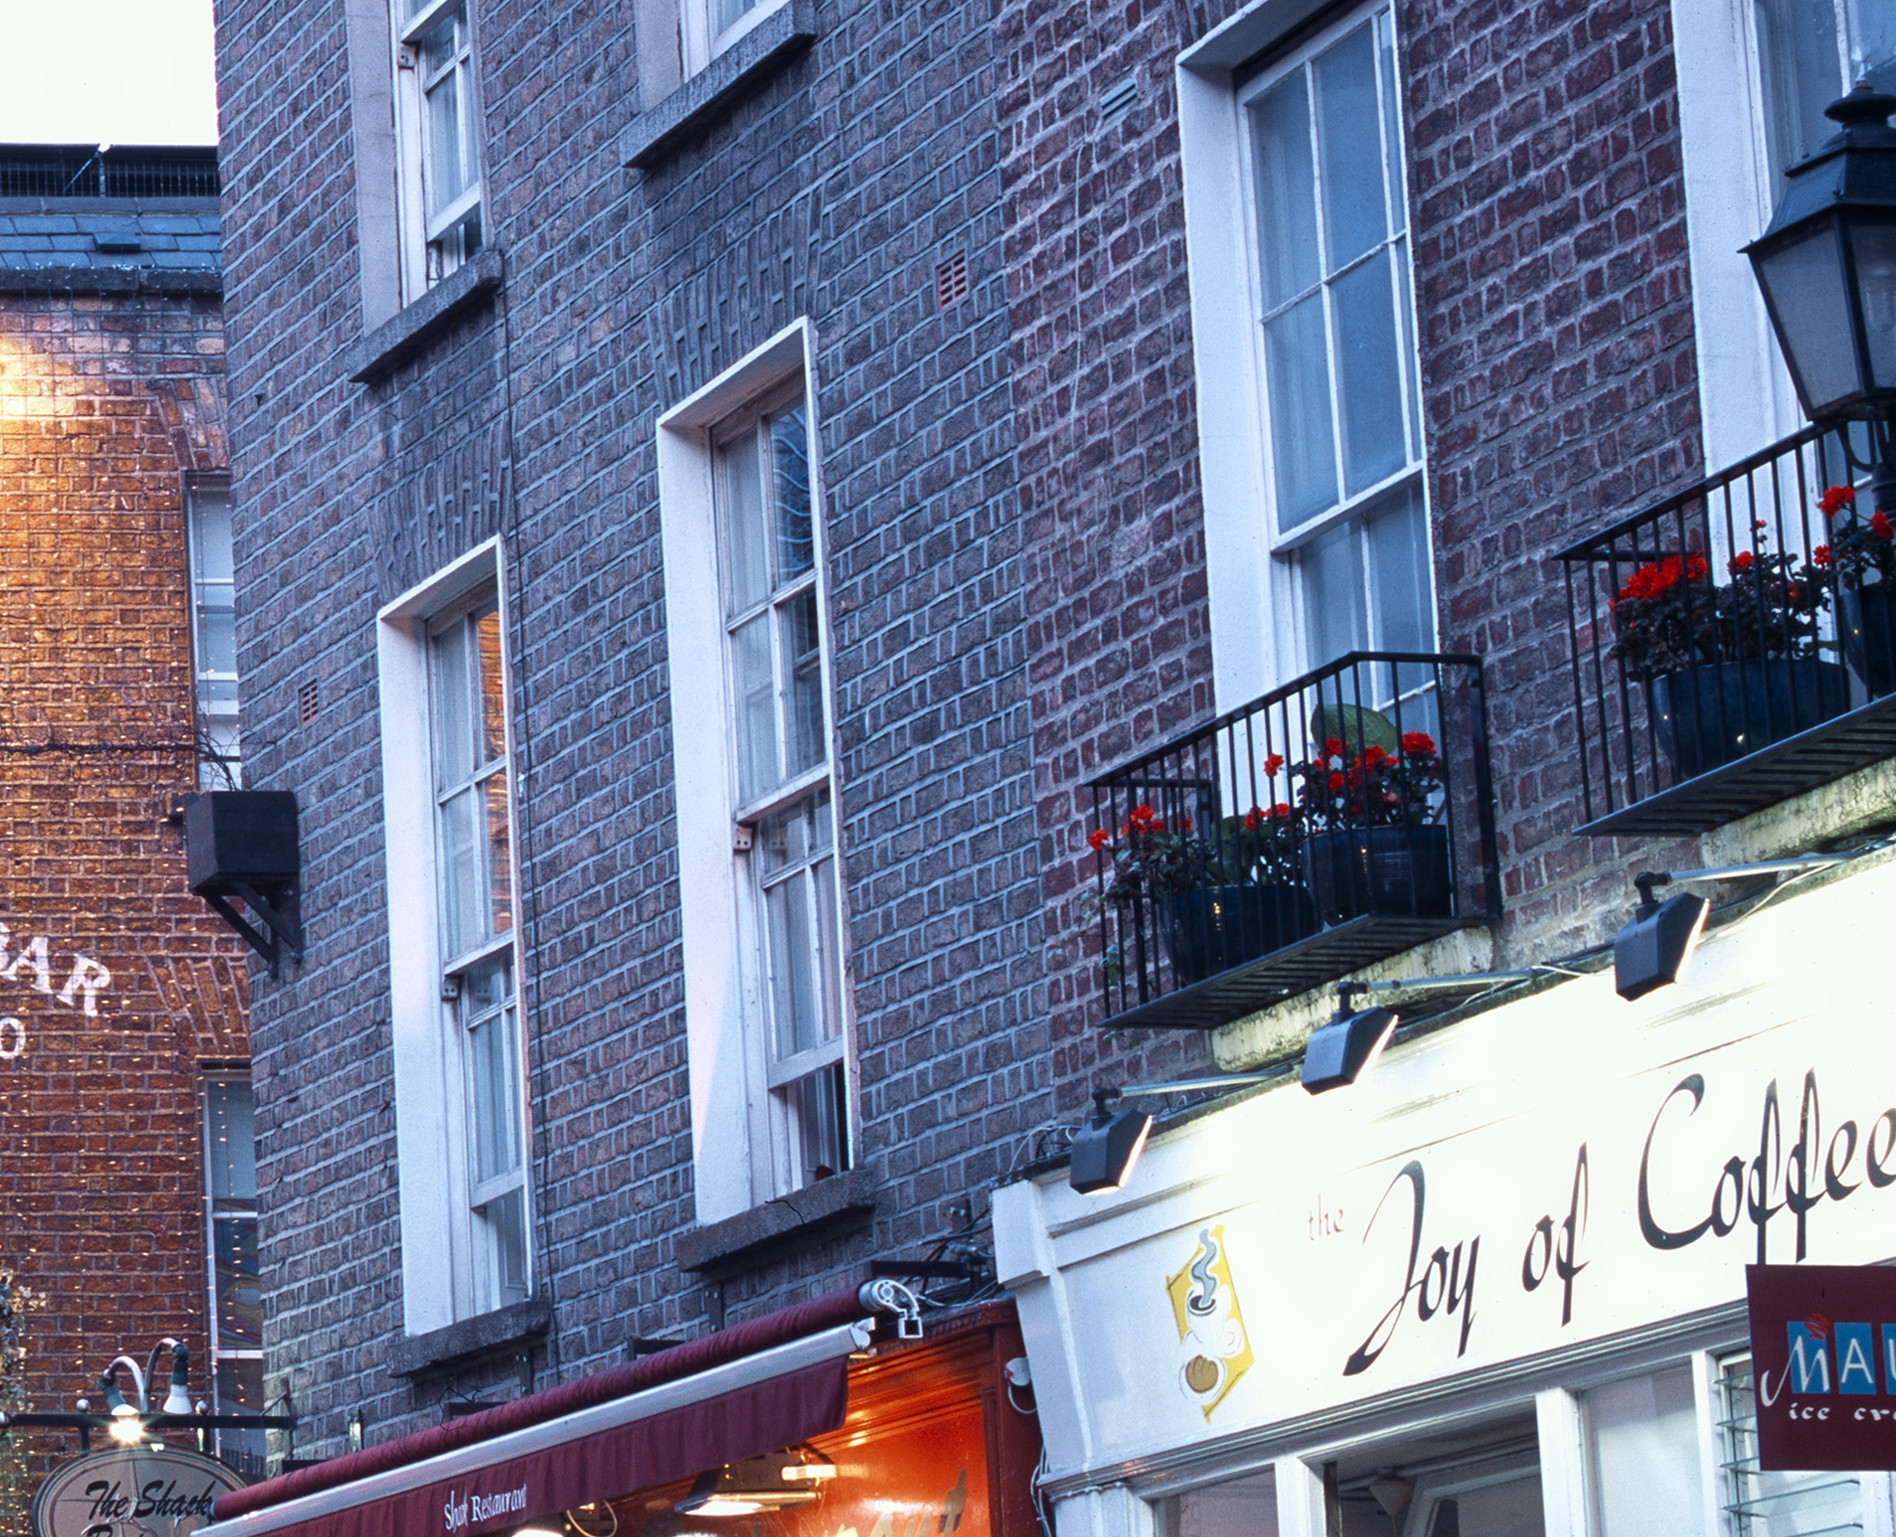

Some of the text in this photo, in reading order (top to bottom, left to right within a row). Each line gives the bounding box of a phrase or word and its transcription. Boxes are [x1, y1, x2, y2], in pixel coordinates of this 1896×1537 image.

[1308, 1193, 1345, 1242] the
[1342, 1068, 1896, 1377] Joy of Coffee
[1789, 1402, 1896, 1421] ice cr
[85, 1479, 217, 1522] The Shack
[470, 1483, 527, 1522] Restaurant
